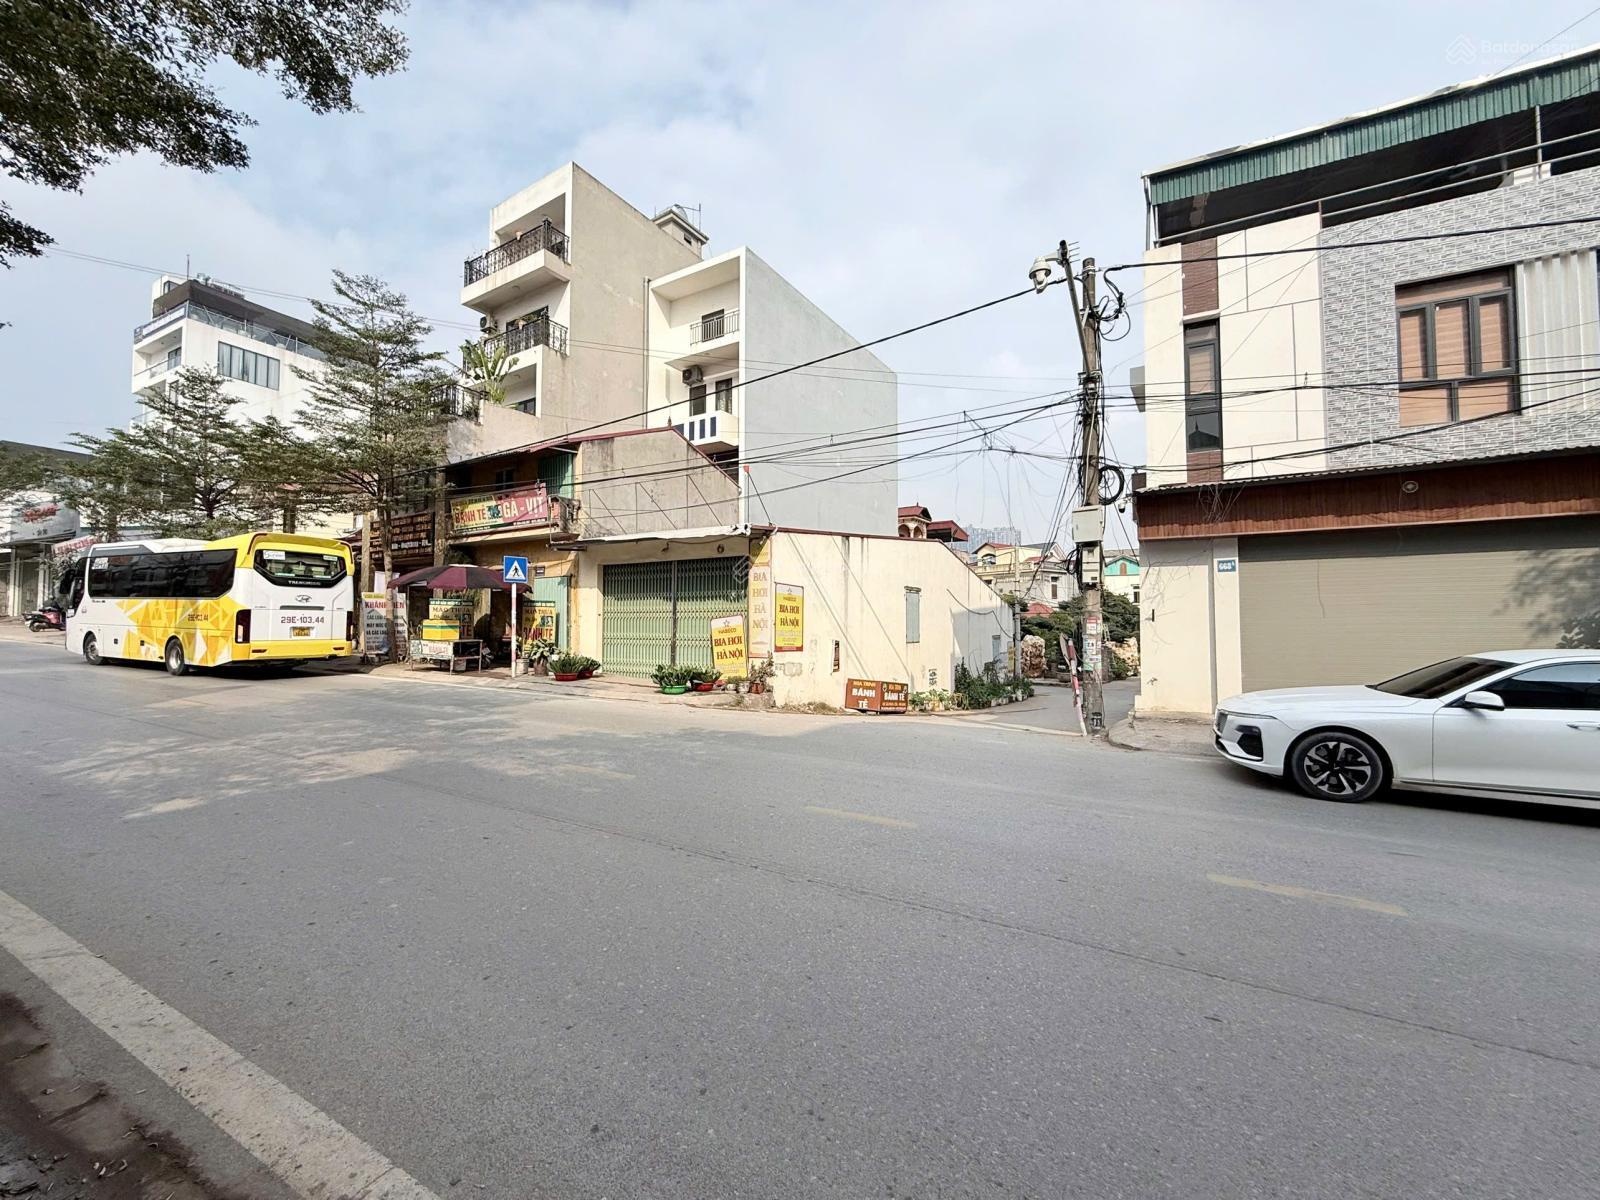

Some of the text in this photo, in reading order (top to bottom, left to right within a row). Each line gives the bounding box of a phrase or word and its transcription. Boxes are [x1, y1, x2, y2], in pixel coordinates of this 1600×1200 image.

[503, 498, 519, 518] GÀ
[525, 496, 543, 518] VỊT
[753, 572, 767, 581] BIA
[779, 604, 789, 613] BIA
[280, 616, 325, 624] 29E-103.44
[780, 616, 789, 626] HÀ
[714, 635, 743, 646] BIA HƠI
[717, 647, 744, 660] HÀ NỘI
[852, 688, 876, 698] BÁNH
[858, 698, 869, 709] TẺ
